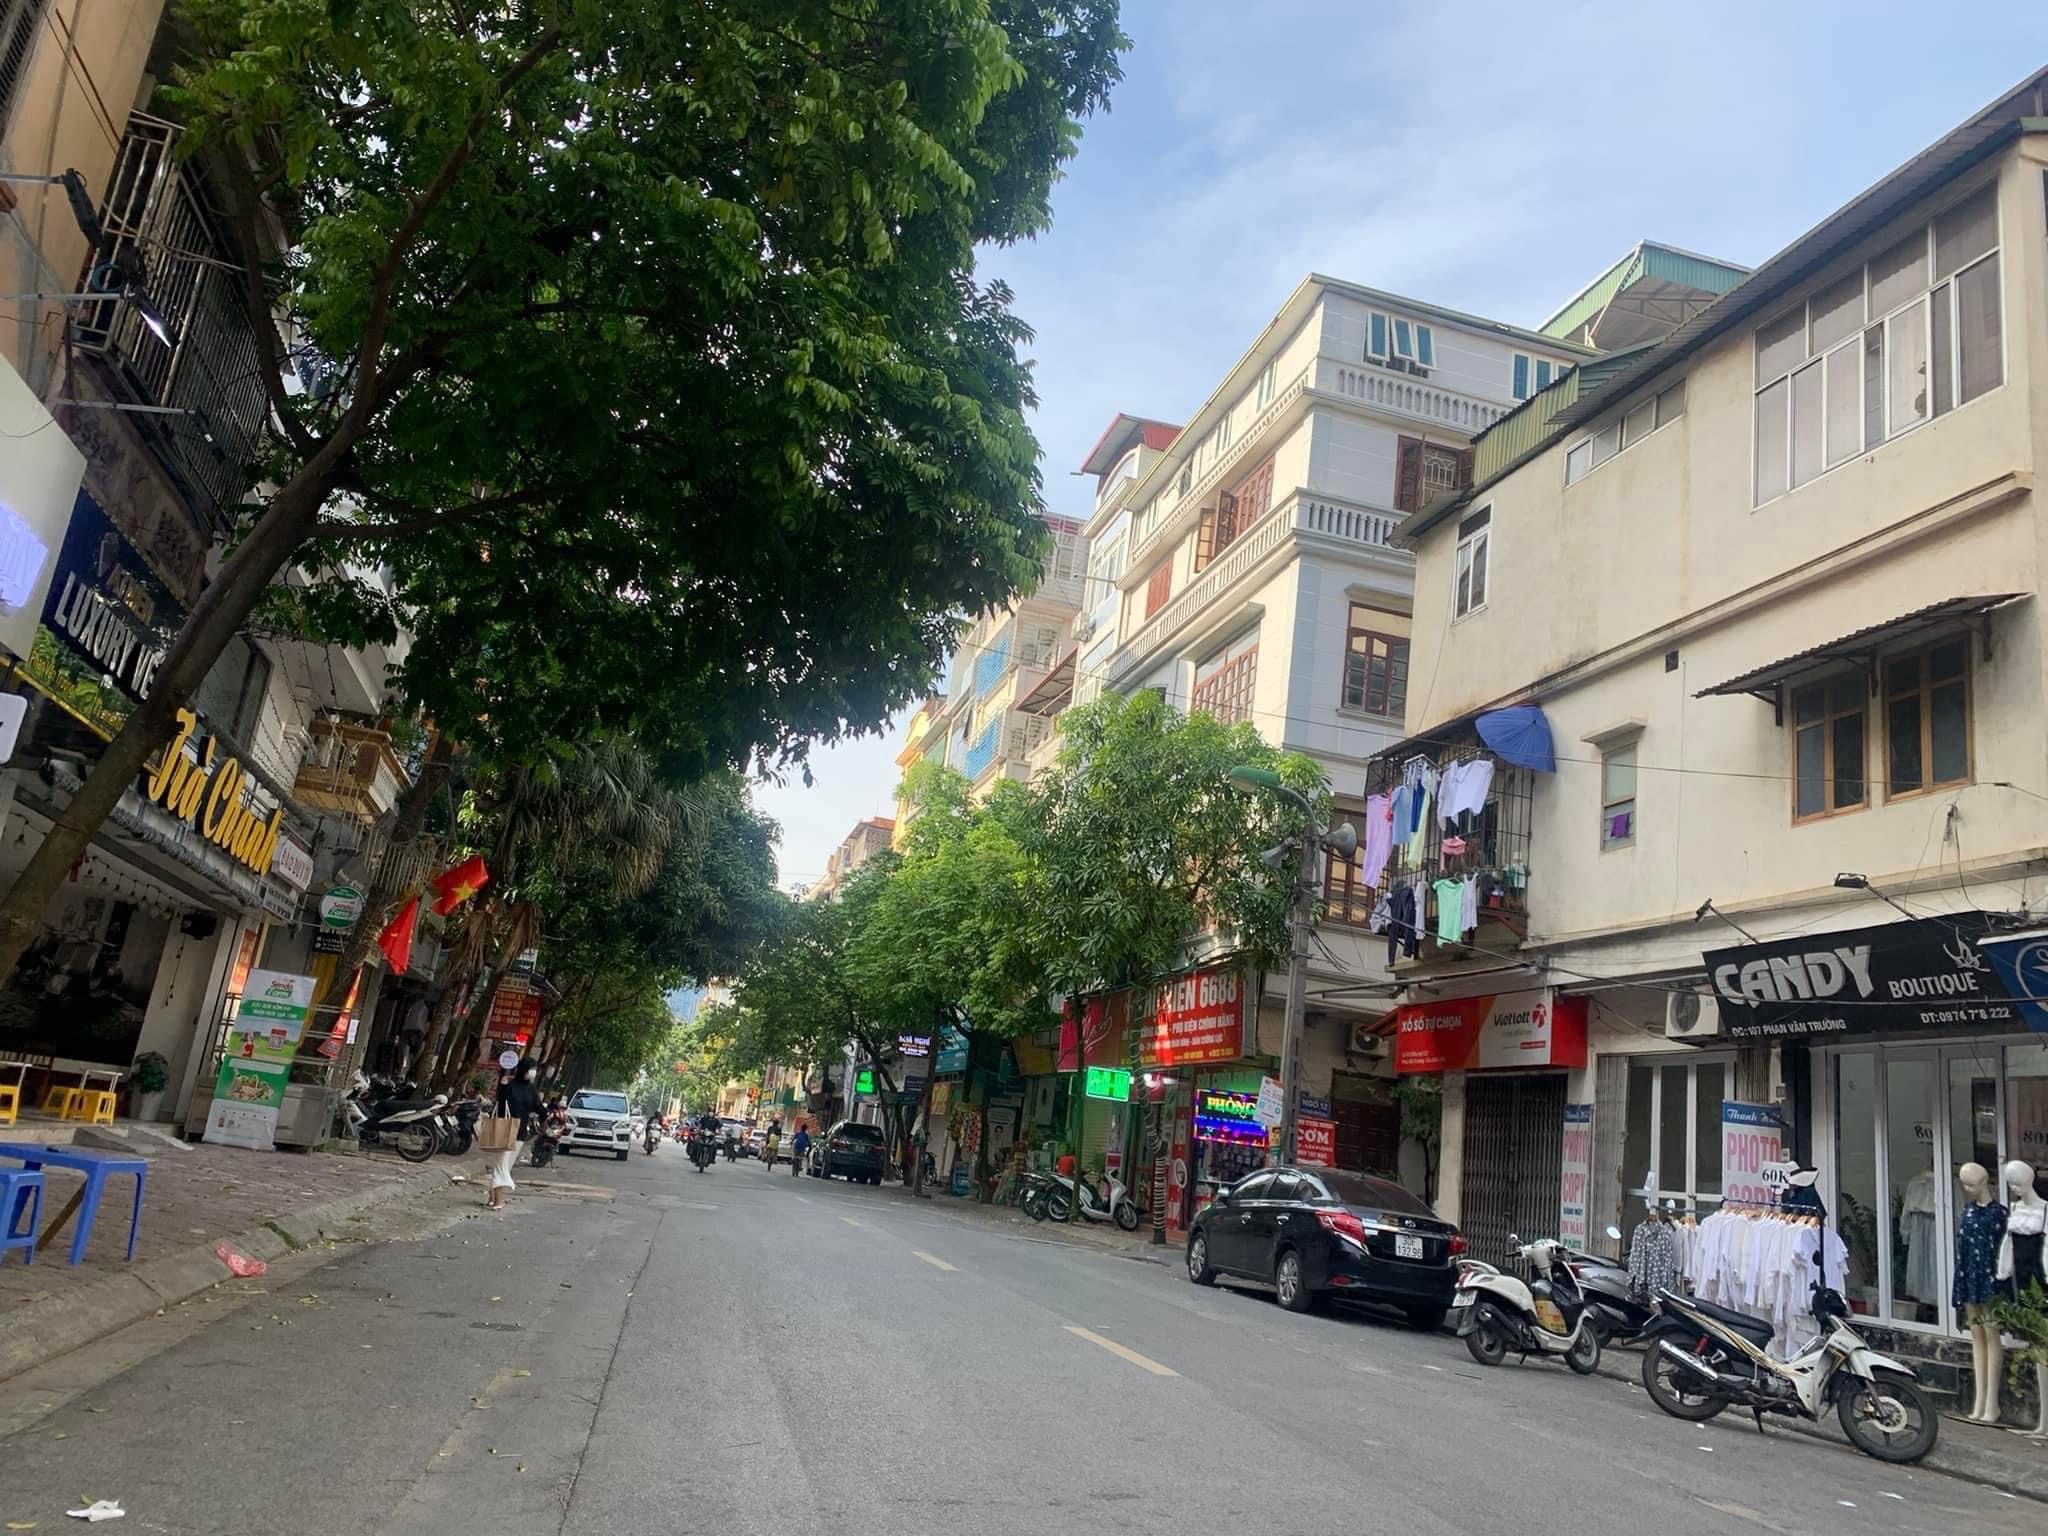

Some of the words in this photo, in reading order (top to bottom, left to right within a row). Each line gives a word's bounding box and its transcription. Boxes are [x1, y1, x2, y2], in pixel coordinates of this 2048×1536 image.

[54, 570, 138, 679] LUXURY
[203, 758, 283, 876] Chanh
[1199, 974, 1238, 1008] 6688
[1715, 945, 1874, 1008] CANDY
[1888, 972, 1979, 999] BOUTIQUE
[1763, 1023, 1788, 1035] PHAN
[1789, 1020, 1807, 1033] VĂN
[1807, 1017, 1847, 1031] TRƯỜNG
[1727, 1108, 1758, 1121] Thanh
[1727, 1132, 1781, 1174] PHOTO
